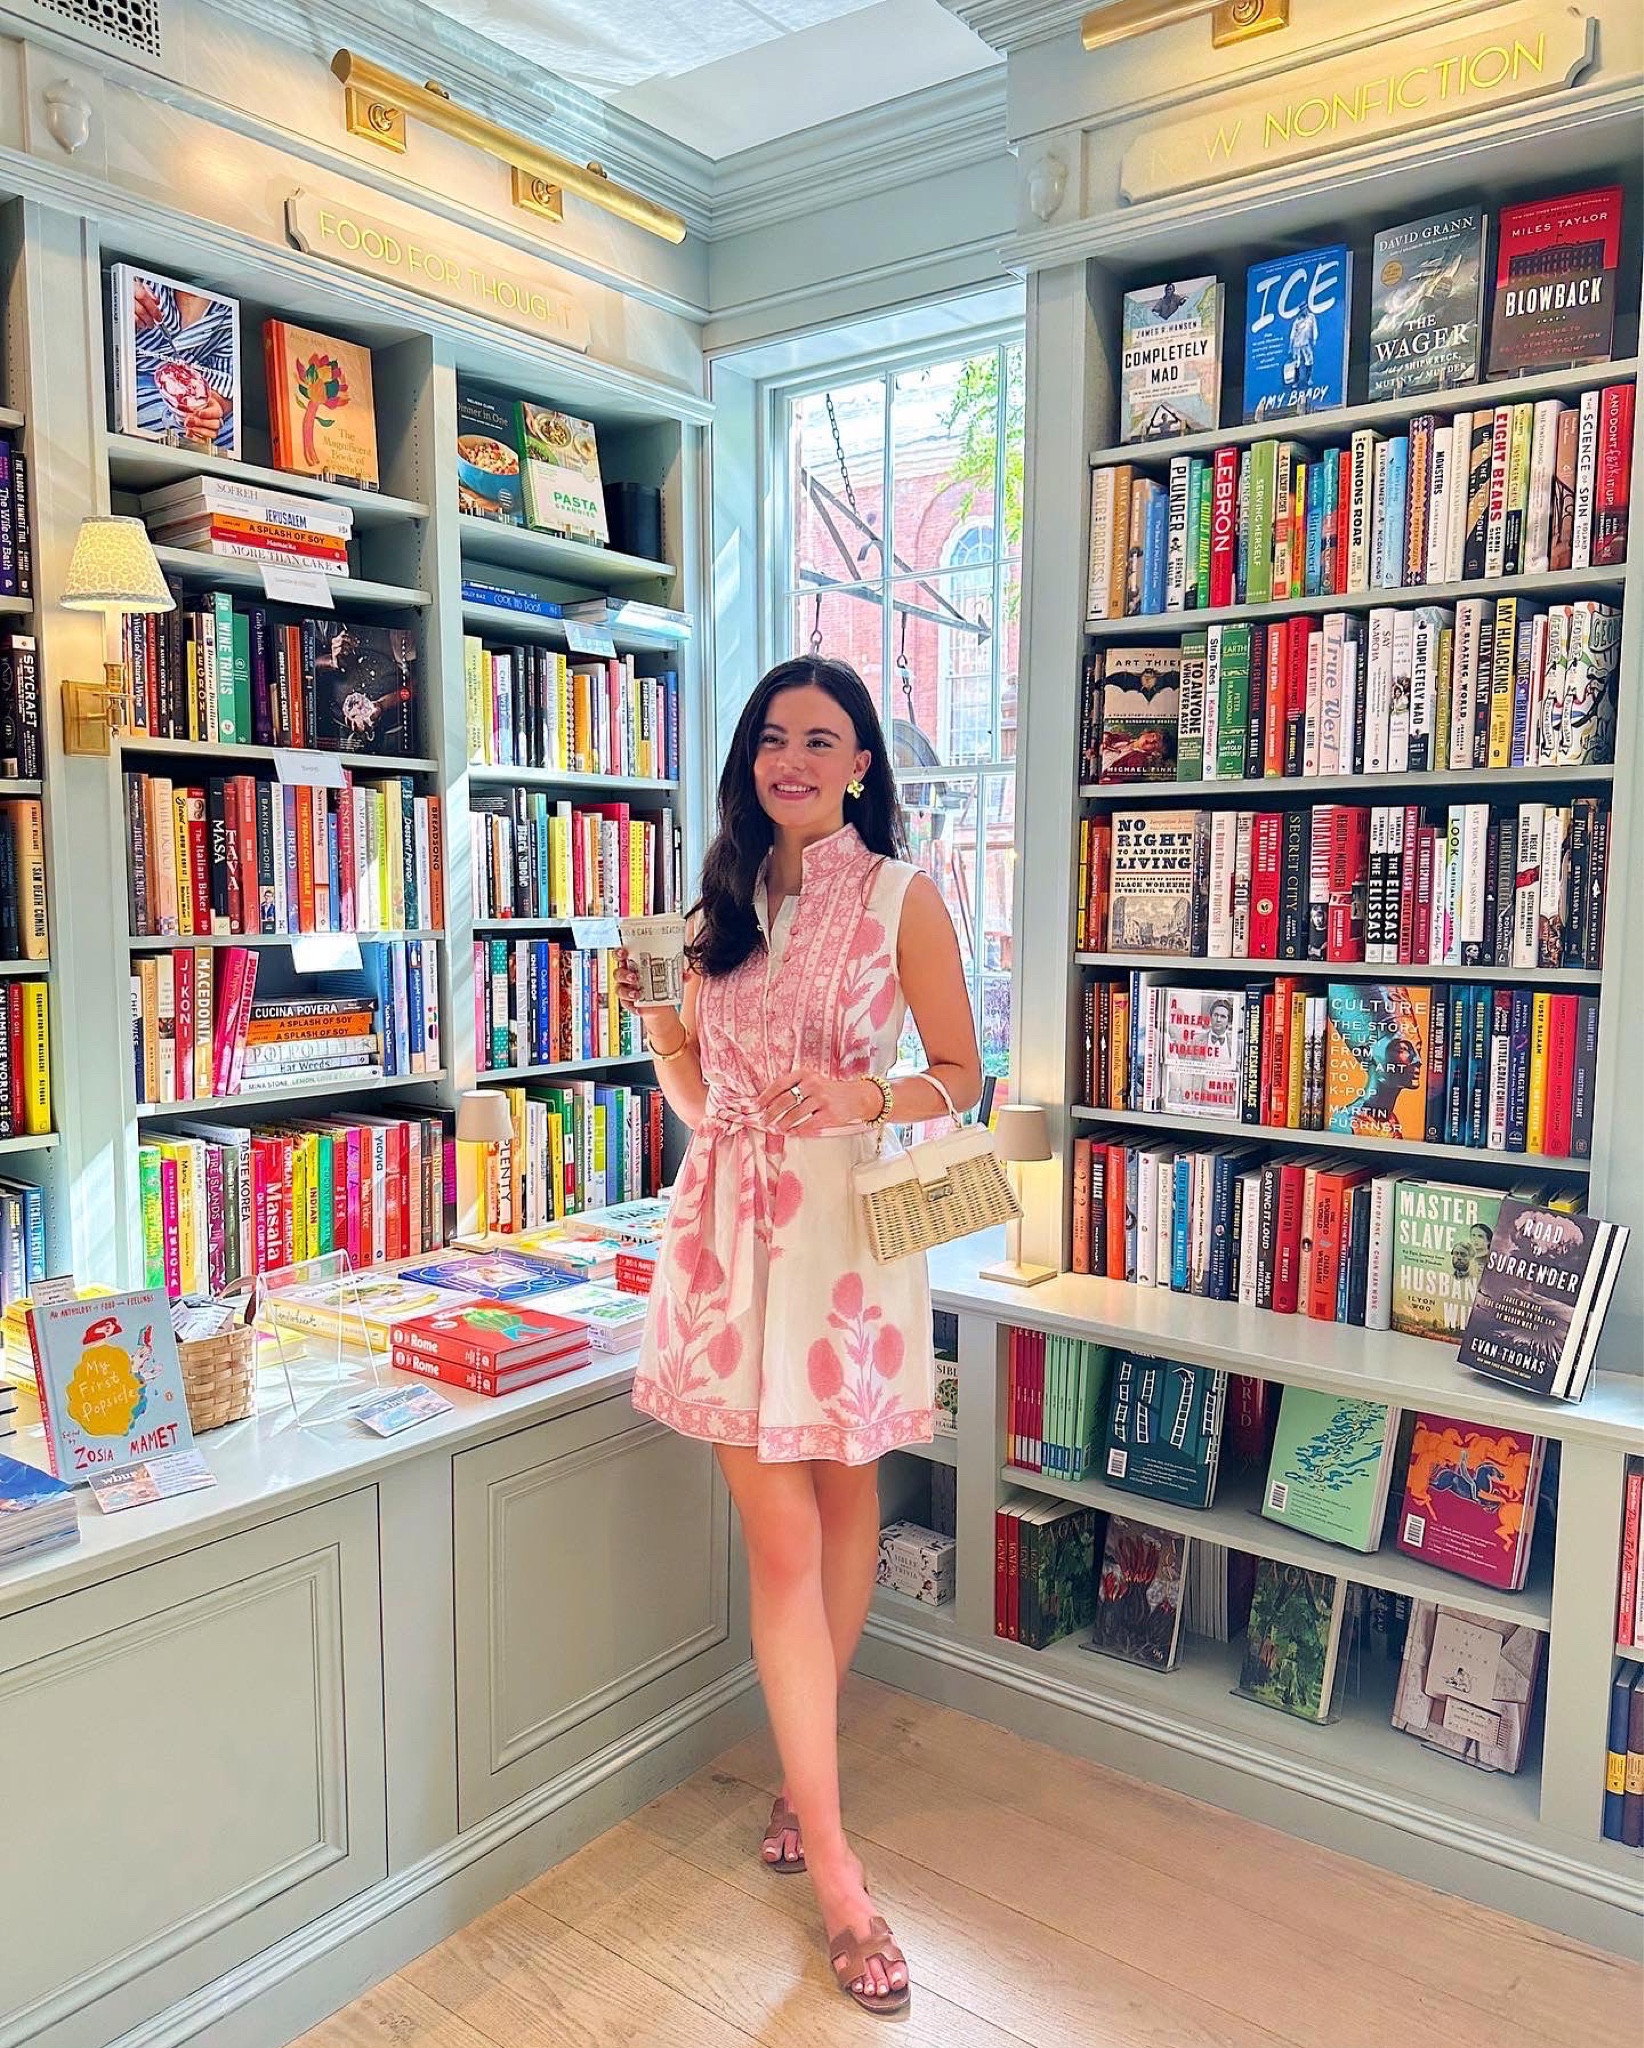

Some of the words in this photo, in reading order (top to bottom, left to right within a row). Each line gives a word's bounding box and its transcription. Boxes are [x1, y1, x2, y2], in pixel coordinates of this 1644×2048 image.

[1264, 32, 1545, 149] NONFICTION
[1379, 233, 1419, 252] DAVID
[1422, 216, 1474, 238] GRANN
[1512, 222, 1551, 237] MILES
[1558, 212, 1608, 228] TAYLOR
[319, 210, 401, 265] FOOD
[408, 244, 462, 290] FOR
[469, 268, 572, 330] THOUGHT
[1251, 261, 1340, 333] ICE
[1505, 276, 1603, 317] BLOWBACK
[1136, 327, 1159, 339] JAMES
[1169, 321, 1197, 332] HANSEN
[1406, 314, 1437, 332] THE
[1124, 339, 1208, 369] COMPLETELY
[1375, 322, 1470, 362] WAGER
[1151, 366, 1178, 384] MAD
[1494, 413, 1508, 462] EIGHT
[1354, 443, 1365, 506] CANNONS
[216, 482, 258, 500] SOFREH
[554, 491, 598, 513] PASTA
[1169, 466, 1186, 532] PLUNDER
[1214, 451, 1233, 552] LEBRON
[1254, 479, 1264, 522] SERVING
[1489, 468, 1504, 522] BEARS
[0, 508, 11, 531] Wife
[265, 508, 307, 530] JERUSALEM
[1352, 509, 1363, 547] ROAR
[2, 533, 11, 546] of
[249, 524, 256, 533] A
[258, 526, 292, 541] SPLASH
[294, 532, 306, 542] OF
[308, 535, 325, 546] SOY
[1253, 523, 1263, 566] HERSELF
[3, 550, 12, 571] Bath
[231, 544, 259, 558] MORE
[268, 548, 300, 566] THAN
[302, 558, 332, 572] CAKE
[1498, 605, 1512, 623] MY
[219, 622, 230, 652] WINE
[1381, 630, 1391, 649] SAY
[1325, 635, 1342, 688] True
[1414, 634, 1427, 700] COMPLETELY
[1461, 632, 1470, 677] BLAZING
[1493, 627, 1511, 694] HIJACKING
[220, 657, 232, 694] TRAILS
[1182, 664, 1191, 686] WHO
[1192, 662, 1203, 679] TO
[23, 654, 38, 728] SPYCRAFT
[1181, 688, 1190, 710] EVER
[1459, 683, 1469, 718] WORLD
[1181, 712, 1190, 735] ASKS
[1190, 683, 1203, 734] ANYONE
[1413, 703, 1425, 725] MAD
[1323, 699, 1341, 752] West
[195, 828, 203, 843] The
[403, 817, 412, 851] Dessert
[431, 806, 440, 871] BREADSONG
[517, 825, 529, 853] Black
[1117, 819, 1146, 832] NO
[1117, 834, 1192, 847] RIGHT
[213, 820, 226, 864] MASA
[287, 830, 296, 870] BREAD
[1236, 836, 1249, 877] BLACK
[1288, 815, 1301, 872] SECRET
[1312, 810, 1332, 879] UNDAUNTED
[196, 844, 206, 880] Italian
[227, 828, 239, 890] TAVA
[404, 852, 415, 883] Person
[518, 855, 530, 887] Smoke
[1116, 857, 1191, 869] LIVING
[1371, 857, 1381, 876] THE
[1388, 857, 1398, 876] THE
[198, 882, 208, 913] Baker
[1234, 881, 1248, 913] FOLK
[1286, 876, 1299, 911] CITY
[1368, 879, 1382, 940] ELISSAS
[1384, 879, 1398, 940] ELISSAS
[243, 959, 256, 998] PASTA
[180, 959, 189, 1037] JIKONI
[198, 959, 210, 1045] MACEDONIA
[255, 1007, 294, 1018] CUCINA
[296, 1004, 338, 1016] POVERA
[1331, 999, 1427, 1016] CULTURE
[238, 999, 250, 1038] NIGHT
[279, 1020, 285, 1028] A
[287, 1018, 321, 1027] SPLASH
[323, 1017, 334, 1025] OF
[336, 1016, 353, 1024] SOY
[283, 1031, 317, 1039] SPLASH
[332, 1027, 349, 1036] SOY
[1170, 1013, 1210, 1026] THREAD
[1333, 1020, 1361, 1030] THE
[1368, 1022, 1419, 1033] STORY
[1168, 1043, 1220, 1058] VIOLENCE
[1184, 1029, 1196, 1041] OF
[1330, 1046, 1374, 1057] FROM
[1330, 1059, 1369, 1072] CAVE
[1375, 1063, 1407, 1074] ART
[0, 1063, 8, 1101] WORLD
[1329, 1085, 1377, 1097] K-POP
[1330, 1072, 1348, 1082] TO
[1328, 1118, 1403, 1133] PUCHNER
[1329, 1105, 1387, 1119] MARTIN
[209, 1152, 220, 1174] FIRE
[240, 1138, 250, 1178] TASTE
[284, 1145, 292, 1187] KOREAN
[211, 1175, 221, 1220] ISLANDS
[241, 1180, 251, 1222] KOREA
[257, 1192, 265, 1203] ON
[309, 1187, 318, 1224] INDIAN
[1263, 1171, 1273, 1209] SAYING
[257, 1205, 265, 1223] THE
[266, 1182, 284, 1261] Masala
[1263, 1210, 1272, 1220] IT
[1401, 1191, 1478, 1225] MASTER
[258, 1225, 266, 1252] CURRY
[1262, 1221, 1272, 1249] LOUD
[1400, 1220, 1456, 1248] SLAVE
[1524, 1219, 1564, 1244] ROAD
[1256, 1260, 1266, 1305] WHITAKER
[1264, 1271, 1272, 1297] MARK
[1401, 1265, 1479, 1300] HUSBAN
[1487, 1252, 1579, 1293] SURRENDER
[50, 1310, 59, 1320] AN
[60, 1304, 92, 1318] ANTHOLOGY
[101, 1301, 116, 1311] FOOD
[127, 1295, 155, 1307] FEELINGS
[1411, 1303, 1431, 1313] WOO
[410, 1334, 439, 1354] Rome
[1471, 1337, 1497, 1358] EVAN
[1501, 1348, 1546, 1375] THOMAS
[86, 1360, 111, 1376] My
[412, 1358, 441, 1376] Rome
[79, 1375, 120, 1398] First
[81, 1390, 139, 1421] Popsicle
[74, 1447, 114, 1470] ZOSIA
[130, 1423, 179, 1455] MAMET
